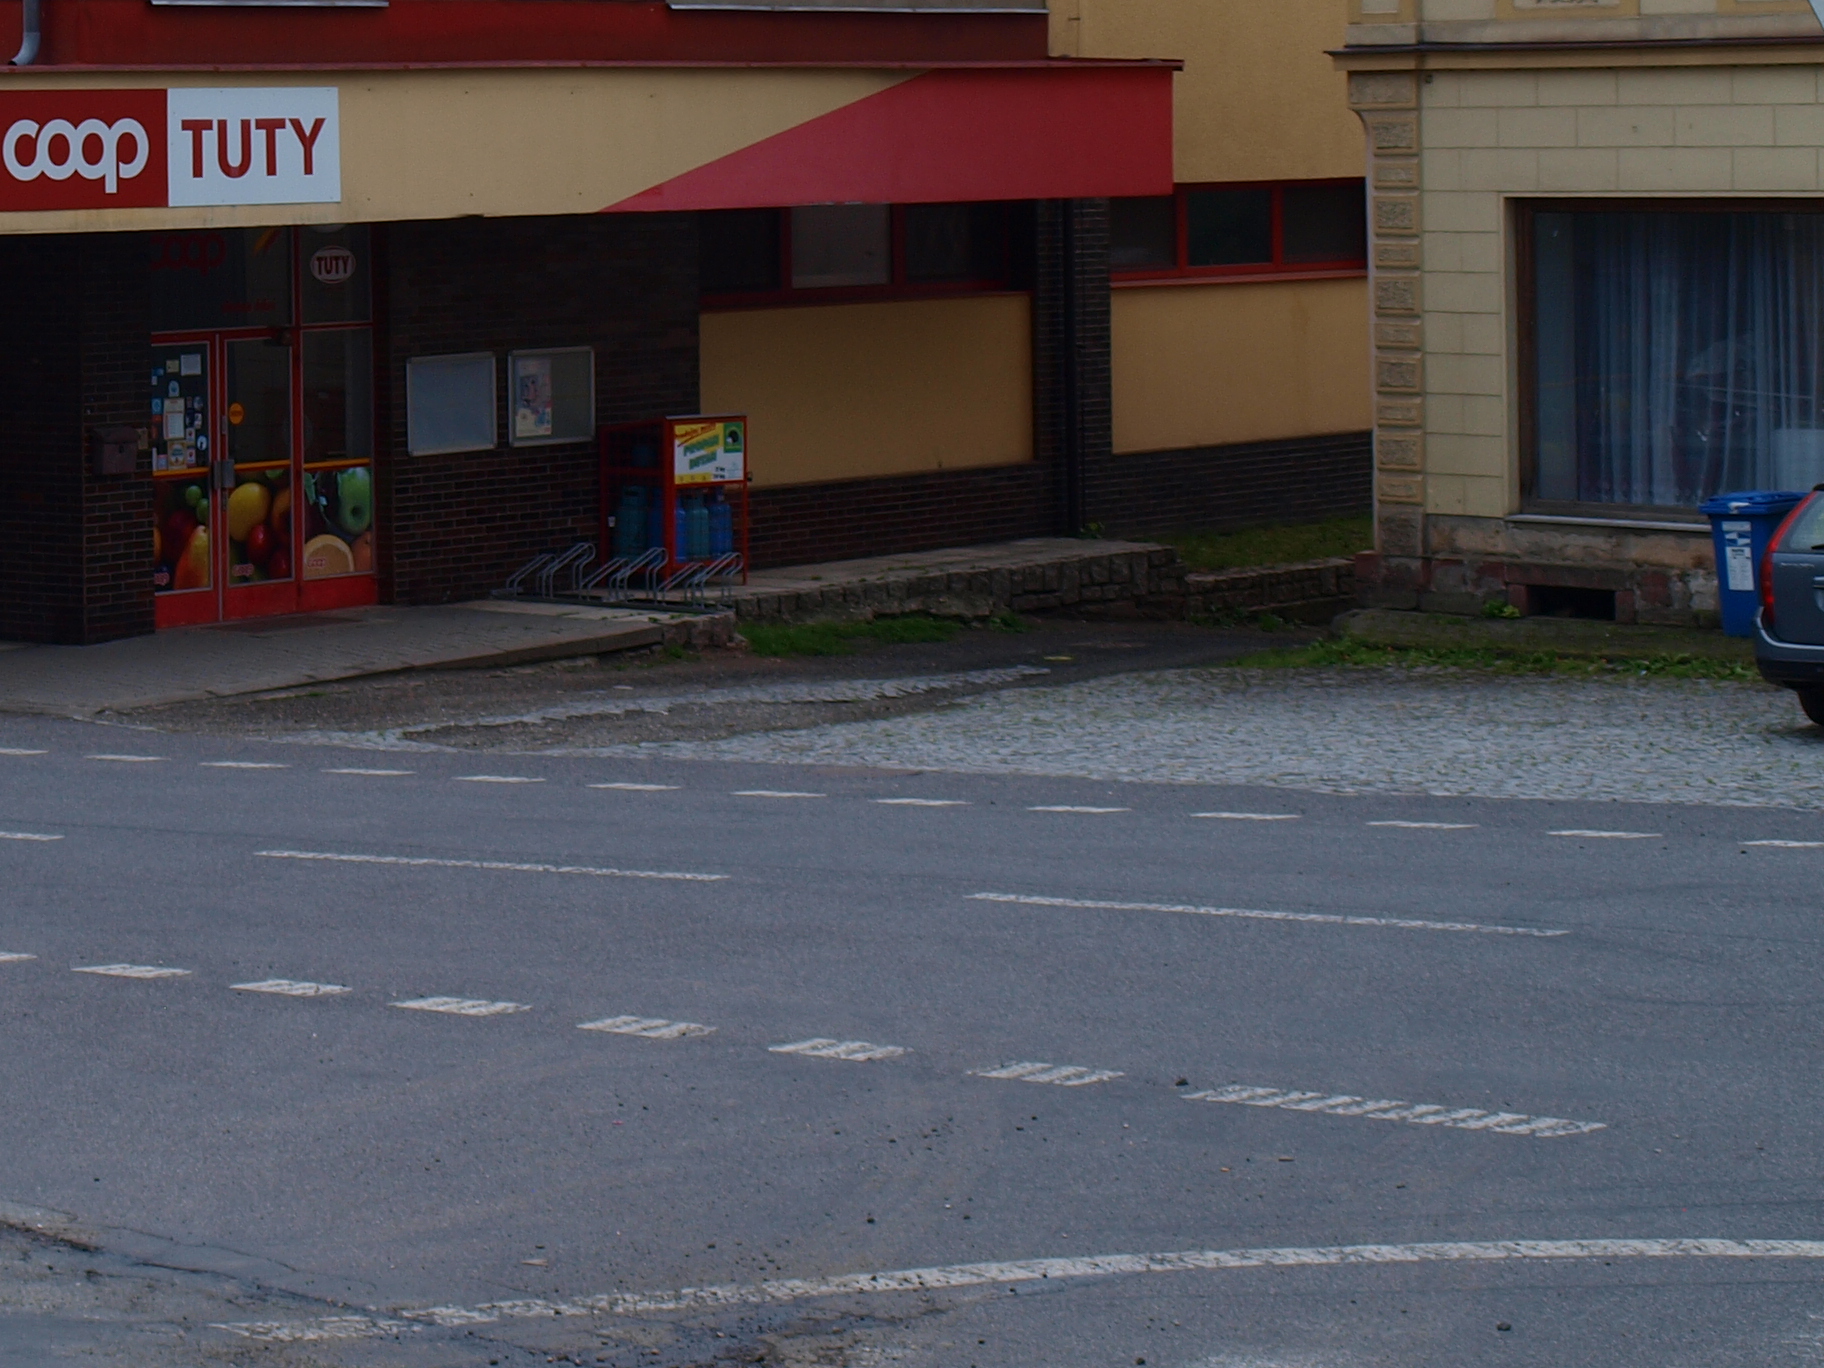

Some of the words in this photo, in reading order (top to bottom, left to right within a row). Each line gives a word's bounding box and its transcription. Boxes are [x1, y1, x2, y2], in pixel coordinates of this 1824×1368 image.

[2, 118, 150, 194] coop
[181, 118, 326, 178] TUTY
[316, 255, 349, 275] TUTY
